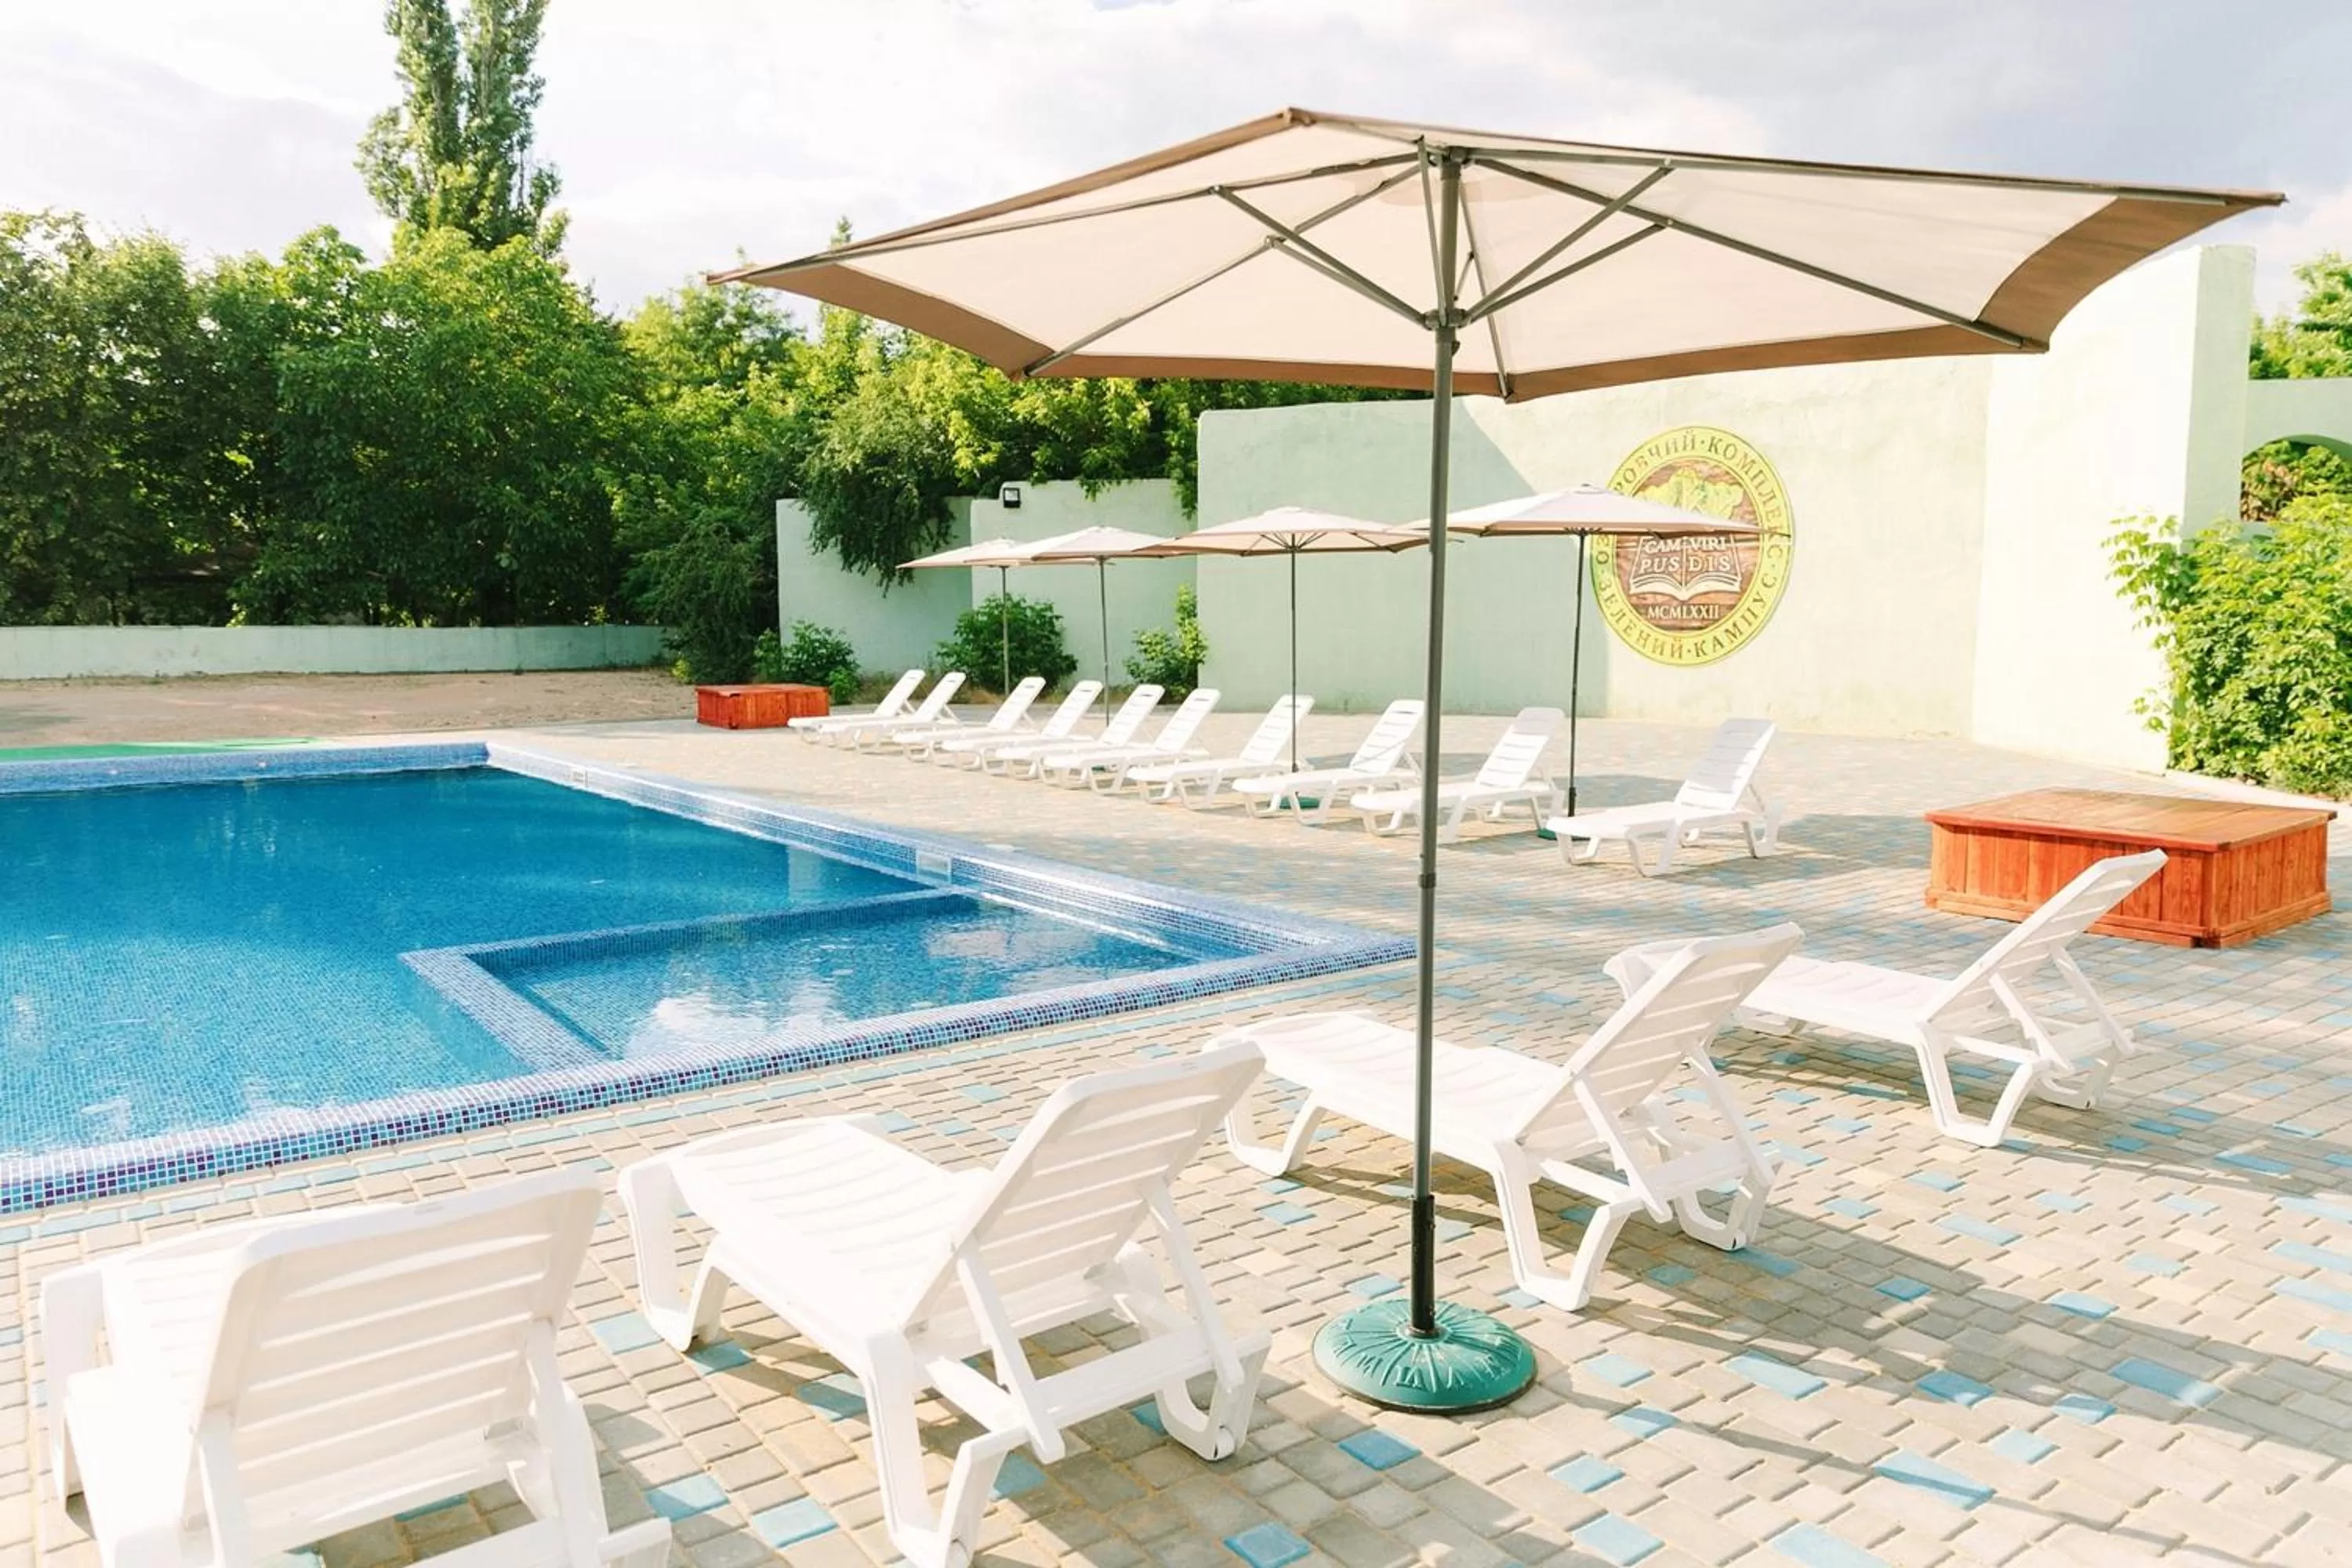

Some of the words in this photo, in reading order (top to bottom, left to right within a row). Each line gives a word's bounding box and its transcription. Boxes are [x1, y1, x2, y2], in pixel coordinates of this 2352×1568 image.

[1708, 436, 1784, 560] КОМПЛЕКС
[1645, 539, 1682, 554] CAM
[1689, 537, 1726, 550] VIRI
[1639, 556, 1681, 574] PUS
[1688, 555, 1731, 572] DIS
[1599, 573, 1683, 659] ЗЕЛЕНИЙ
[1693, 573, 1777, 658] КАМПУС
[1647, 604, 1719, 619] MCMLXXII
